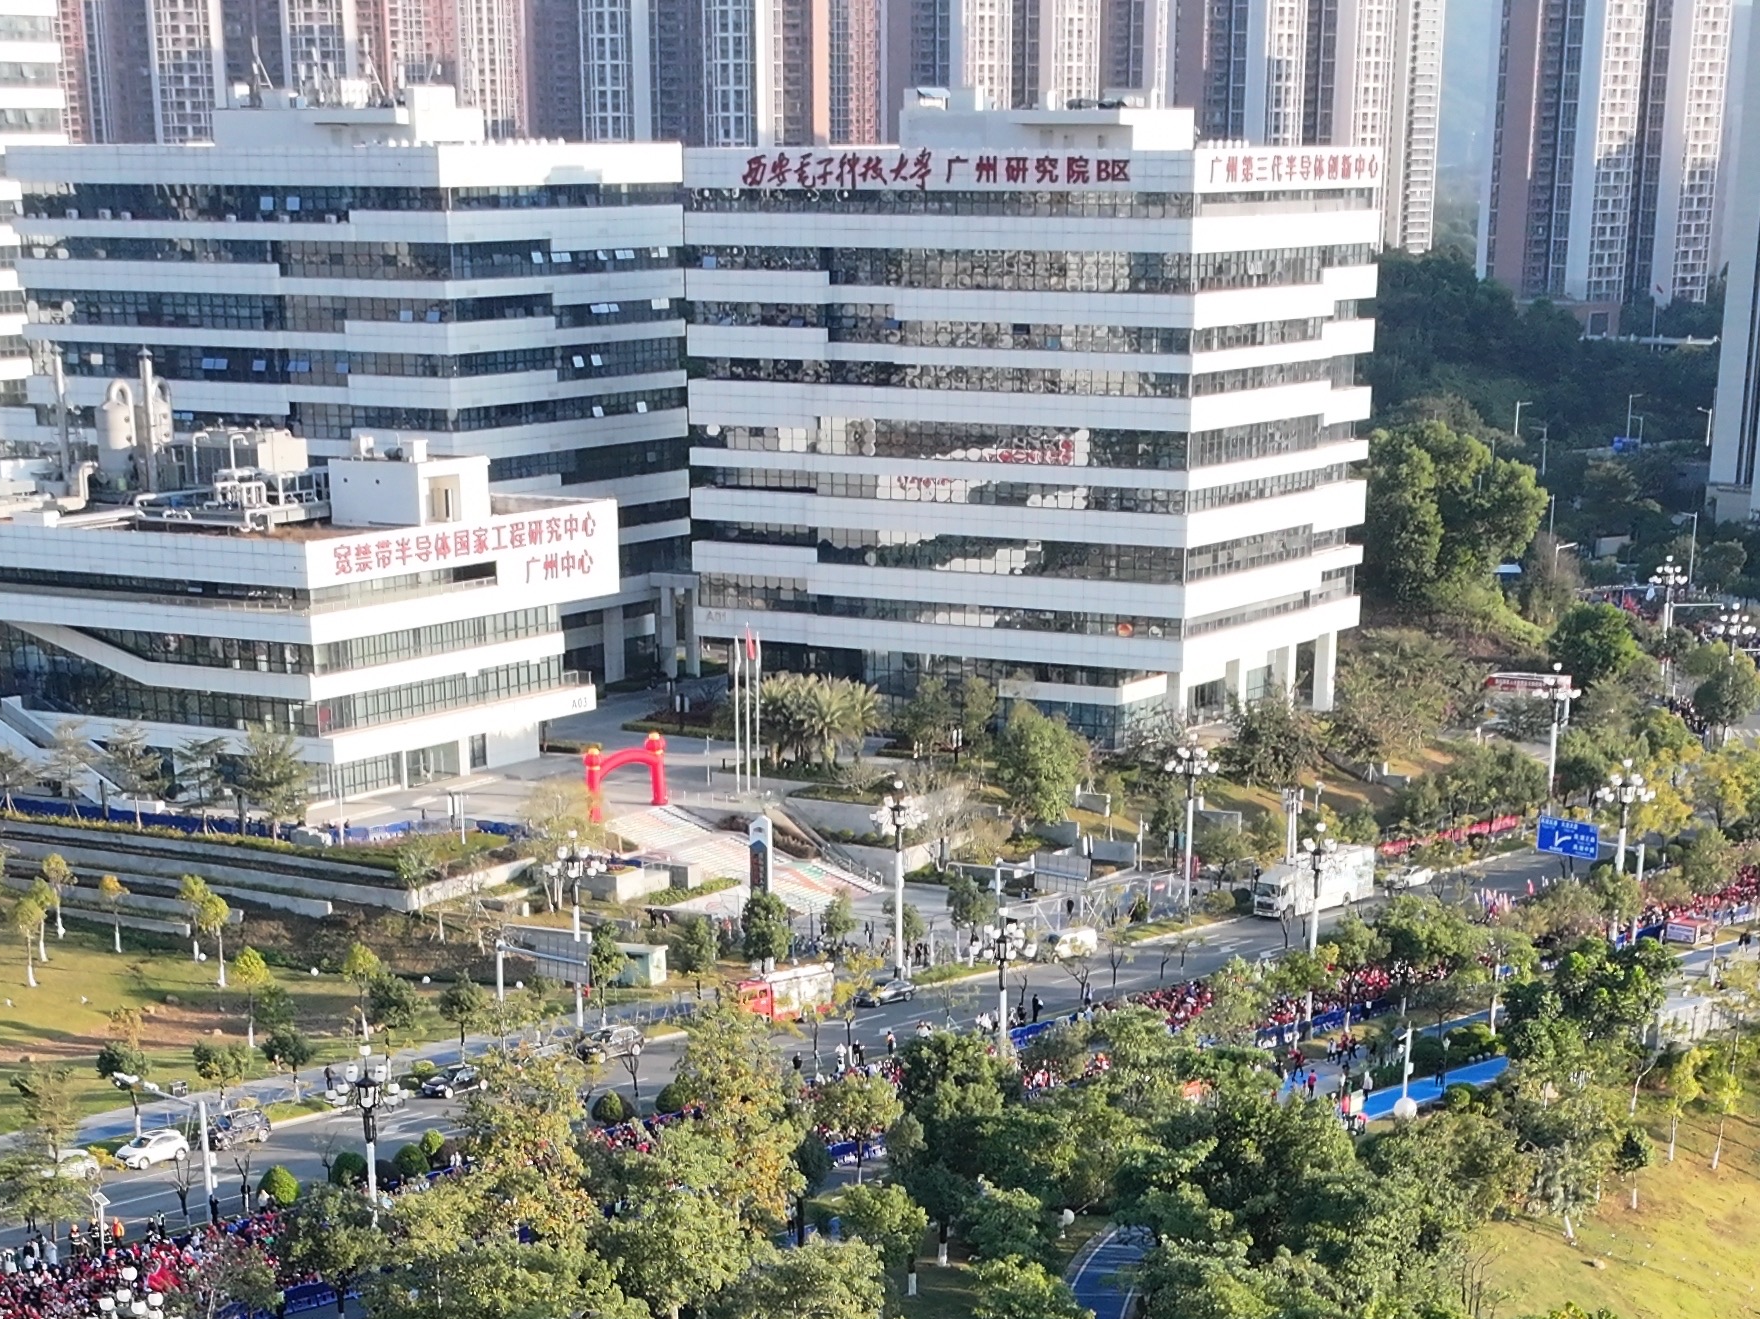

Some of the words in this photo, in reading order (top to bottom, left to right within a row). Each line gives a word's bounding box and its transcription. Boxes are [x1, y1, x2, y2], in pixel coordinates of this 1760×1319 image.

[945, 156, 1131, 185] 广州研究院B区
[1210, 153, 1379, 184] 广州第三代半导体创新中心
[333, 511, 596, 576] 宽禁带半导体国家工程研究中心
[525, 549, 594, 584] 广州中心
[572, 698, 588, 710] A03
